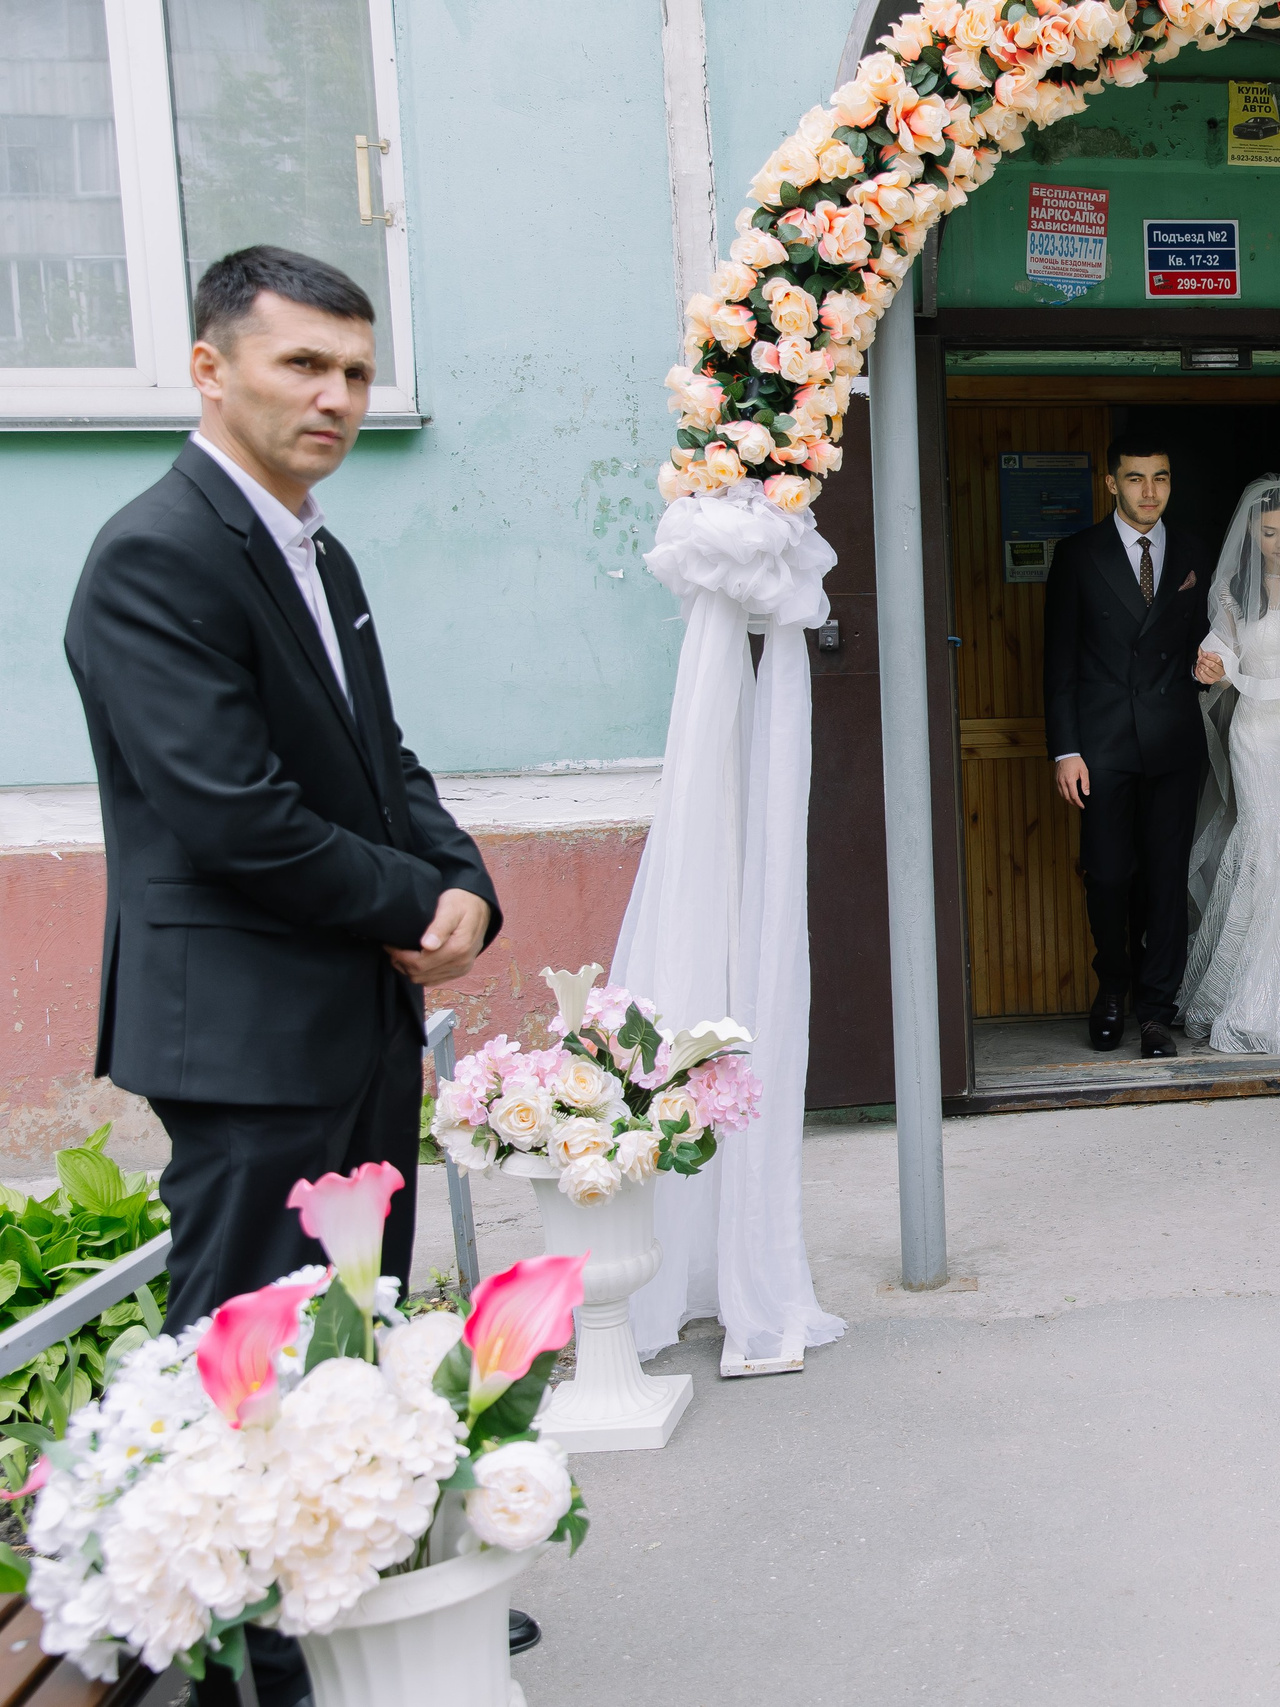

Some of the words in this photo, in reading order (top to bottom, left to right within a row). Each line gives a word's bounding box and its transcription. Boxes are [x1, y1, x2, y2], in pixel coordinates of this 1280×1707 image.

[1244, 95, 1270, 104] ВАШ
[1241, 104, 1272, 113] АВТО
[1032, 187, 1106, 203] БЕСПЛАТНАЯ
[1042, 198, 1095, 211] ПОМОЩЬ
[1030, 206, 1106, 225] НАРКО-АЛКО
[1030, 220, 1105, 235] ЗАВИСИМЫМ
[1153, 230, 1205, 244] Подъезд
[1207, 230, 1227, 242] №2
[1029, 232, 1104, 260] 8-923-333-77-77
[1029, 256, 1059, 265] ПОМОЩЬ
[1060, 258, 1103, 269] БЕЗДОМНЫМ
[1168, 254, 1186, 266] Кв.
[1189, 254, 1219, 266] 17-32
[1177, 278, 1231, 290] 299-70-70
